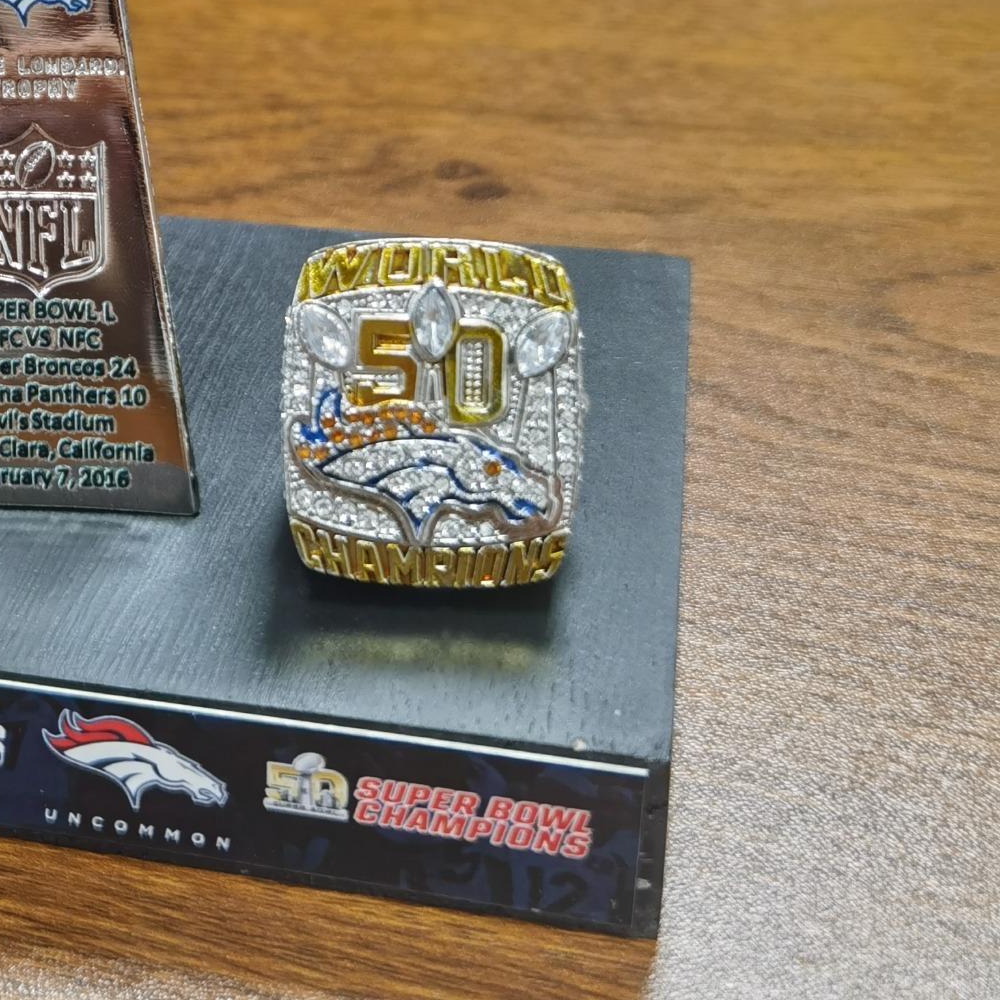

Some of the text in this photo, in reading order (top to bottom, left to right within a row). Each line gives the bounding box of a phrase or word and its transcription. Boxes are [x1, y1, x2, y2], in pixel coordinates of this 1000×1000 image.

[17, 56, 126, 77] LOMBARDI
[35, 300, 97, 321] BOWL
[27, 327, 52, 348] VS
[58, 327, 102, 350] NFC
[23, 355, 104, 379] Broncos
[109, 358, 137, 379] 24
[350, 316, 507, 428] 50
[26, 383, 117, 405] Panthers
[120, 386, 148, 407] 10
[30, 411, 117, 433] Stadium
[57, 440, 156, 464] California
[56, 468, 76, 490] 7,
[78, 468, 131, 489] 2016
[290, 516, 568, 588] CHAMPIONS
[353, 776, 594, 837] SUPER BOWL
[44, 807, 232, 853] UNCOMMON
[352, 803, 593, 860] CHAMPIONS
